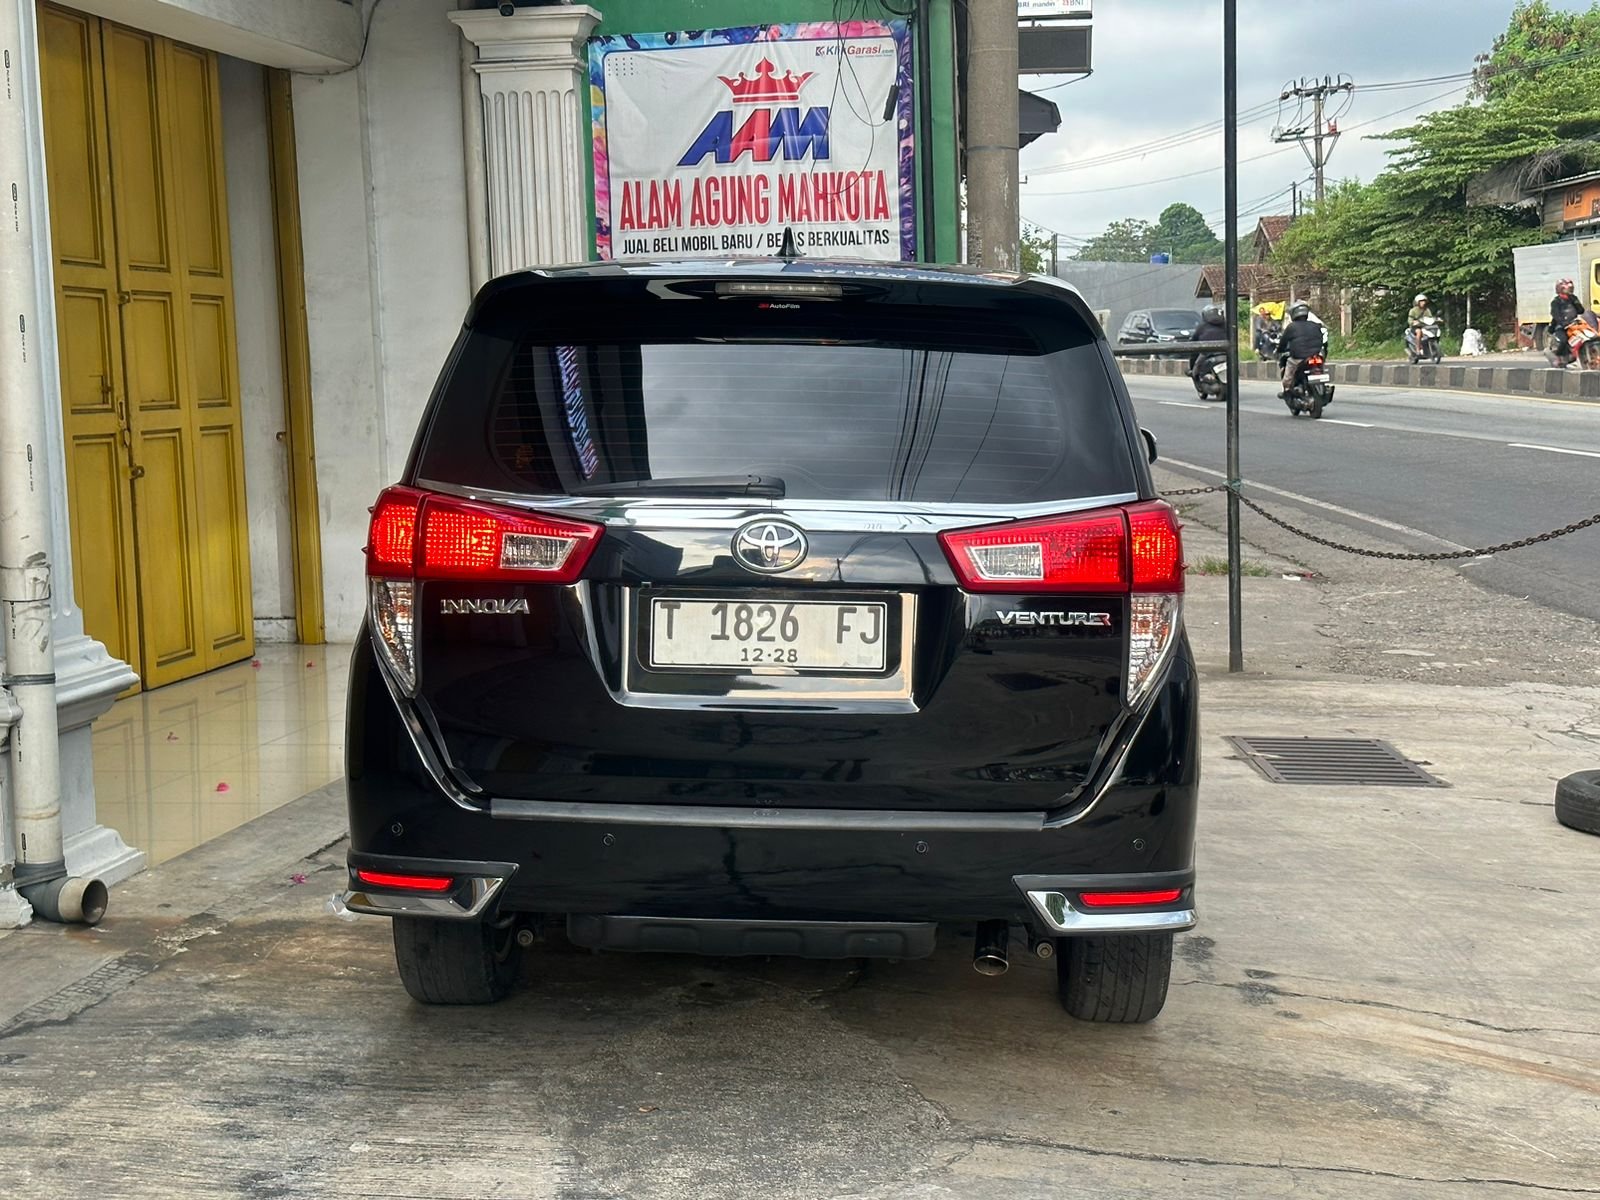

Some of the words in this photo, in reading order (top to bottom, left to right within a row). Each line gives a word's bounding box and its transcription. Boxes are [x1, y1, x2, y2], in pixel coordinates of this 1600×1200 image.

[676, 106, 830, 167] AAM
[620, 178, 682, 231] ALAM
[689, 174, 770, 228] AGUNG
[777, 169, 891, 224] MAHKOTA
[623, 238, 650, 255] JUAL
[653, 237, 679, 253] BELI
[681, 235, 719, 252] MOBIL
[721, 233, 753, 250] BARU
[767, 231, 805, 248] BES
[808, 229, 890, 247] BERKUALITAS
[440, 598, 530, 615] INNOVA
[660, 601, 681, 640] T
[710, 602, 799, 643] 1826
[836, 606, 881, 645] FJ
[995, 610, 1111, 626] VENTURER
